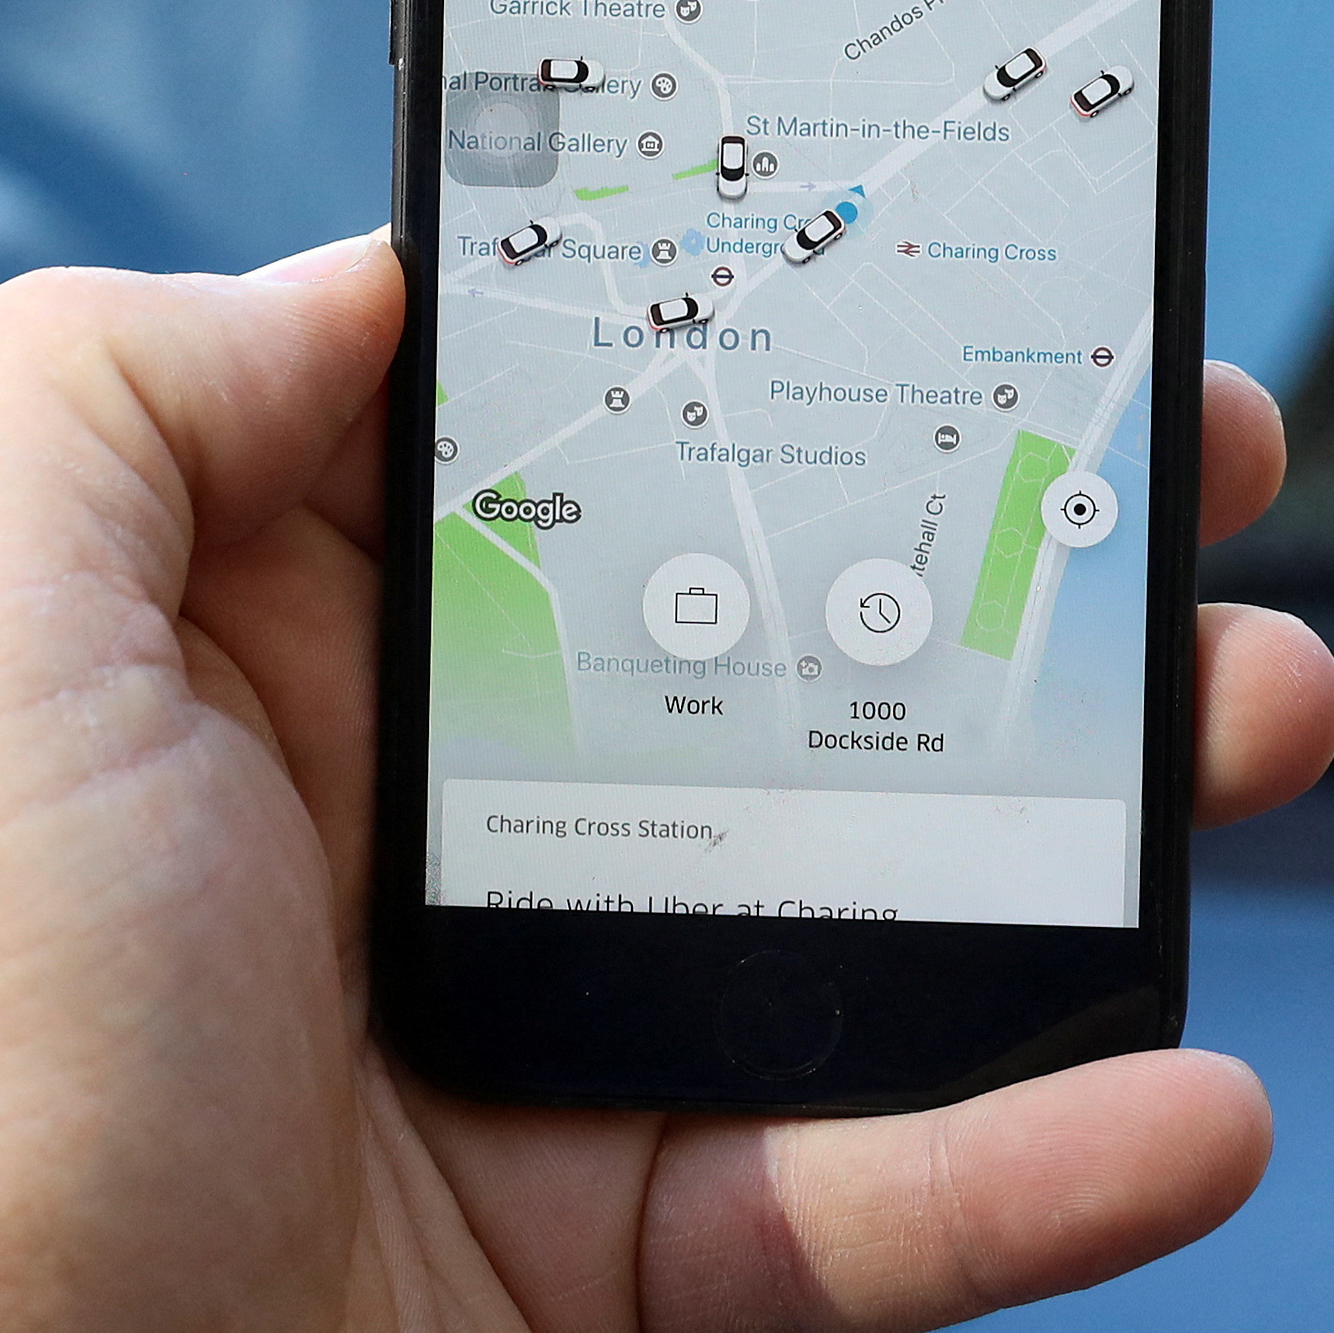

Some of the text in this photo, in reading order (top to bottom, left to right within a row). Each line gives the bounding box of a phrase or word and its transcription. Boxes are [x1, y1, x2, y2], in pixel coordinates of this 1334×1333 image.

[844, 5, 924, 61] Chandos
[746, 115, 1011, 142] St Martin-in-the-Fields
[448, 130, 627, 157] National Gallery
[706, 212, 778, 233] Charing
[561, 238, 641, 263] Square
[927, 242, 1057, 262] Charing Cross
[592, 317, 772, 351] London
[963, 345, 1082, 364] Embankment
[770, 380, 983, 406] Playhouse Theatre
[676, 440, 866, 466] Trafalgar Studios
[472, 488, 581, 530] Google
[926, 494, 946, 515] Ct
[577, 652, 786, 679] Banqueting House
[665, 695, 724, 715] Work
[849, 701, 906, 720] 1000
[808, 730, 944, 752] Dockside Rd
[486, 815, 713, 840] Charing Cross Station
